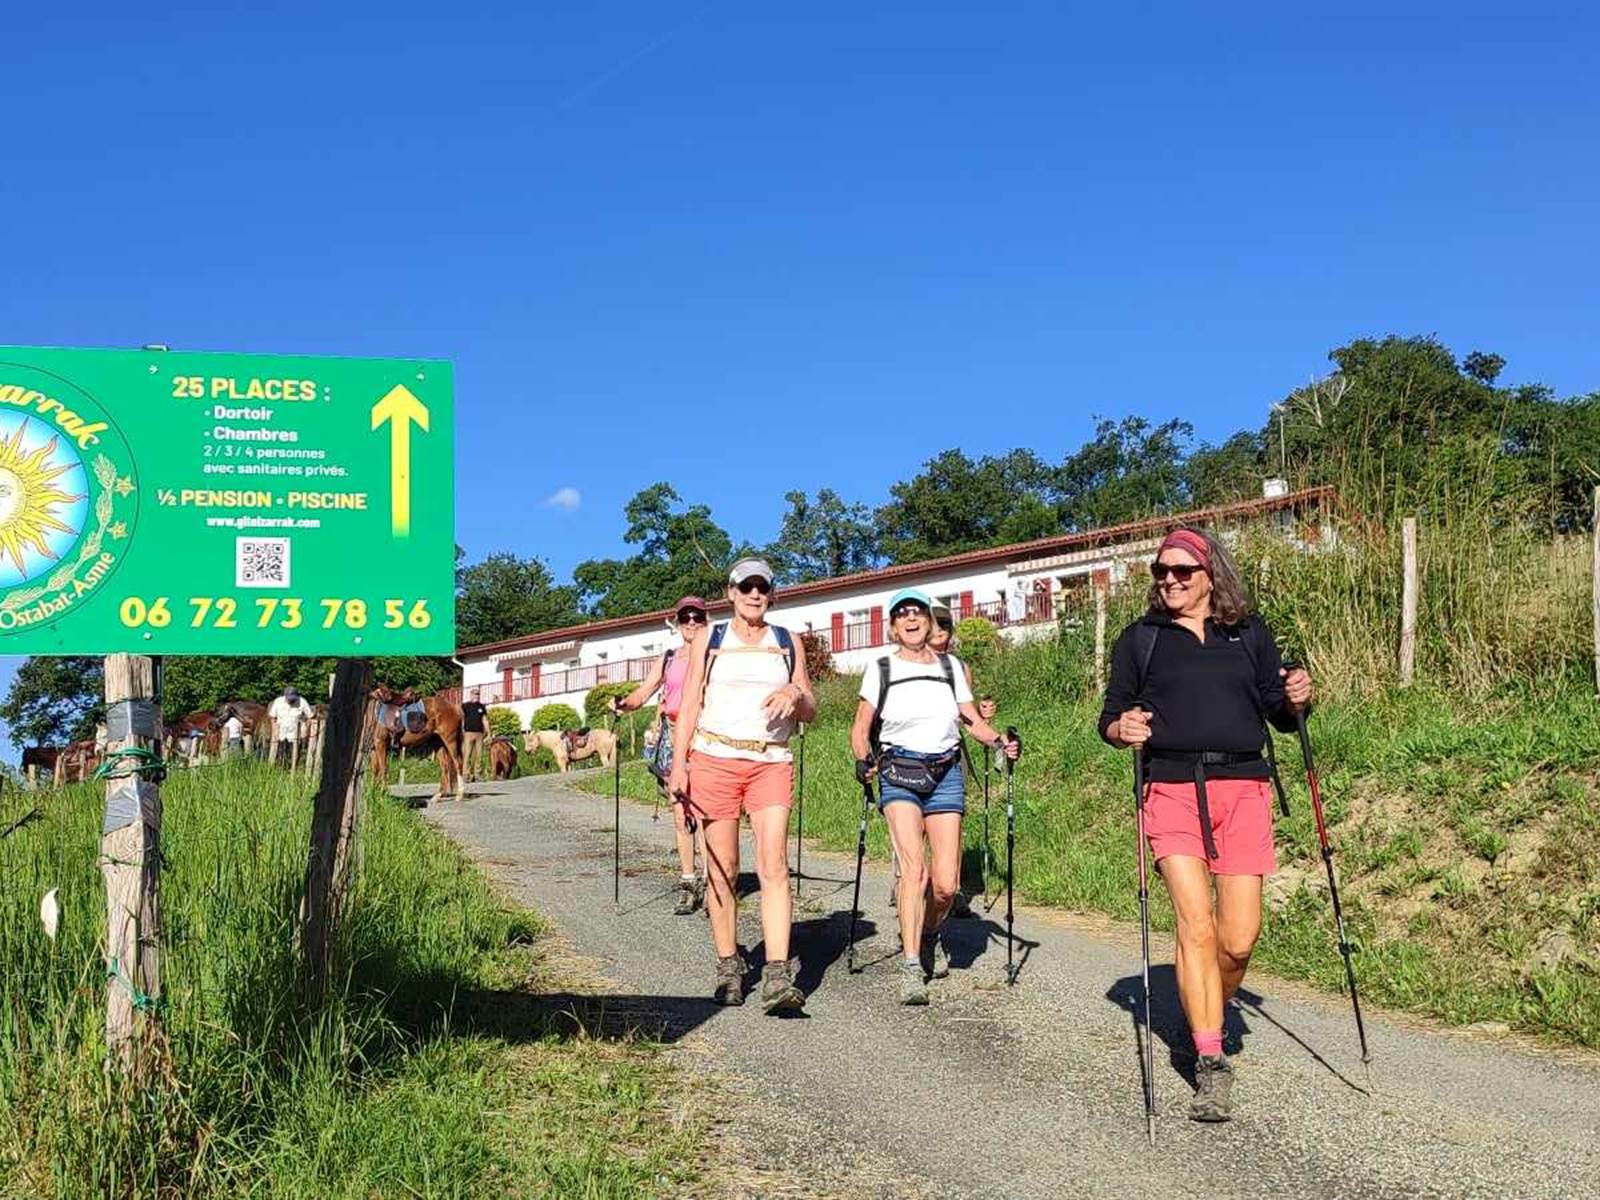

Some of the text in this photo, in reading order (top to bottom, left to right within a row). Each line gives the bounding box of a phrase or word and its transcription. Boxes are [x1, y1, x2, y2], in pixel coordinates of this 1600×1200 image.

[172, 376, 205, 398] 25
[210, 377, 317, 401] PLACES
[213, 405, 273, 421] Dortoir
[213, 426, 298, 442] Chambres
[256, 448, 326, 460] personnes
[203, 463, 349, 477] avec sanitaires privés.
[180, 490, 272, 508] PENSION
[287, 492, 368, 510] PISCINE
[0, 551, 116, 629] Ostabat-Asme
[119, 596, 431, 629] 06 72 73 78 56
